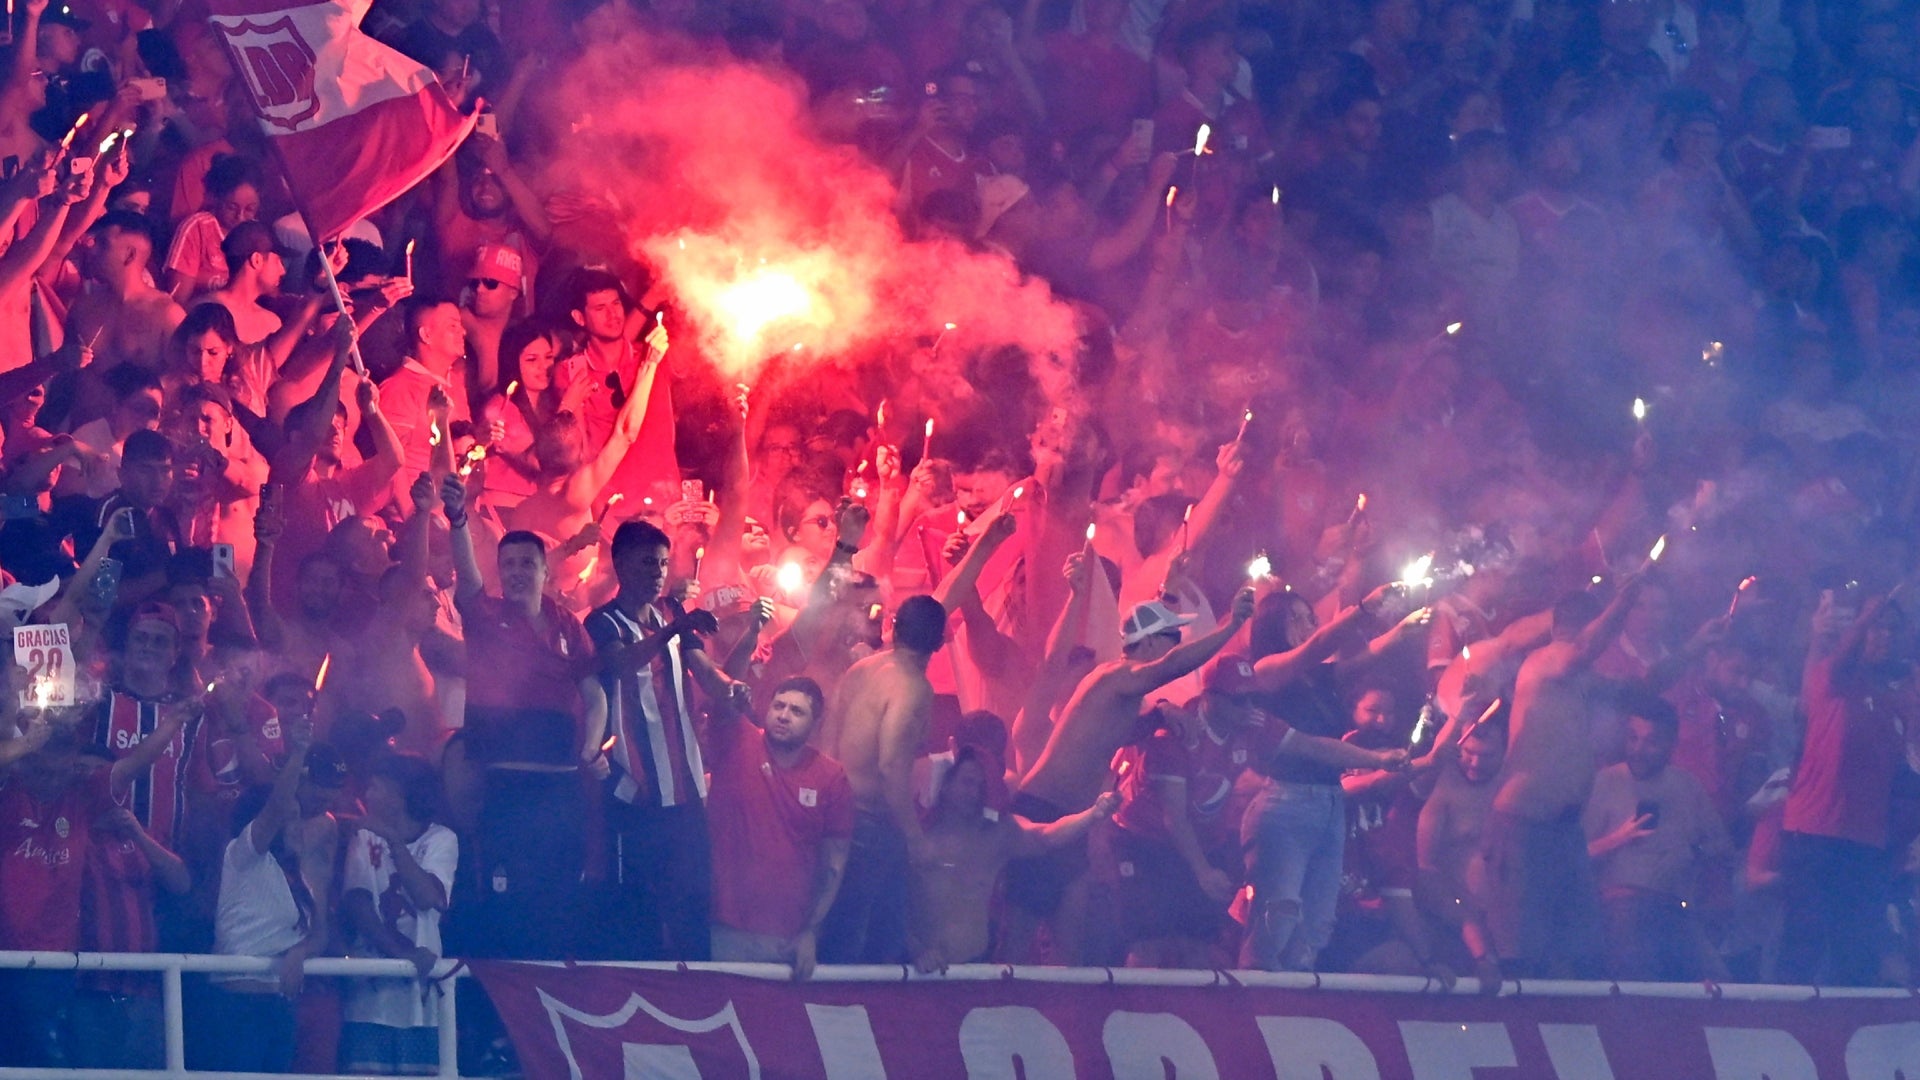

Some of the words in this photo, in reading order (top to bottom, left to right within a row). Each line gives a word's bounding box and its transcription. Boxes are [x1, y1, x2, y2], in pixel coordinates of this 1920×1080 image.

[17, 628, 67, 648] GRACIAS
[28, 648, 62, 683] 20
[116, 730, 174, 758] SAA
